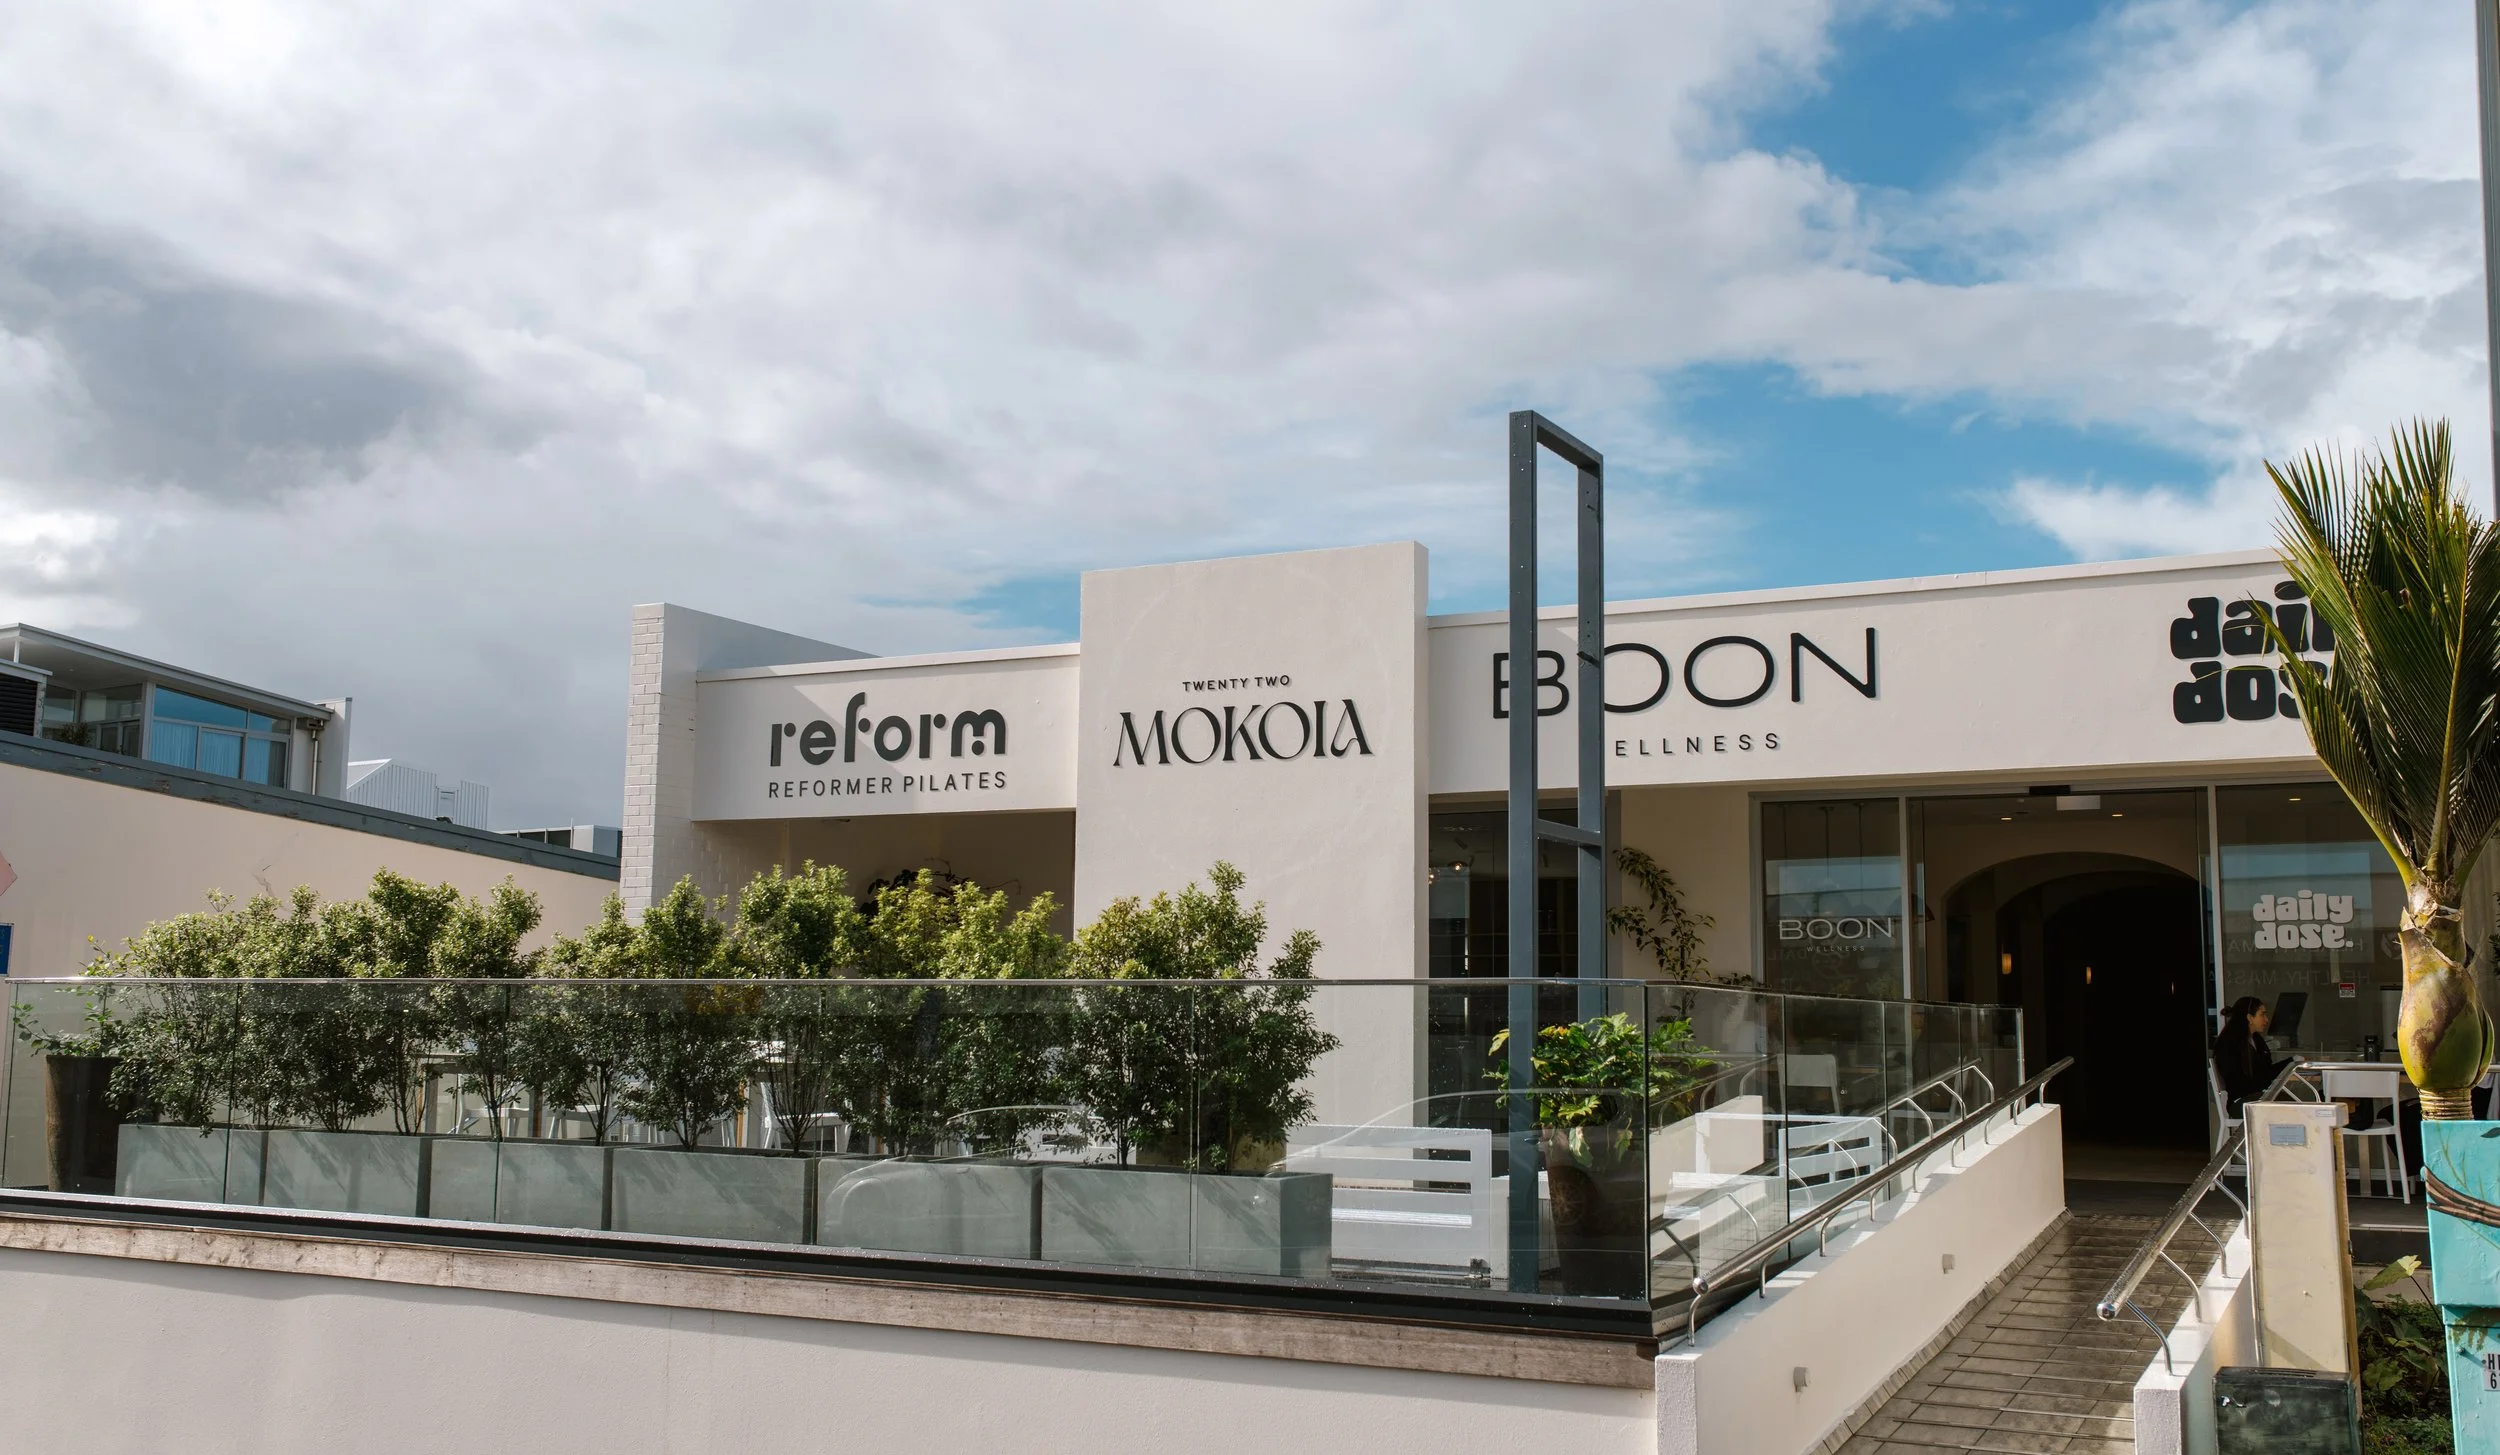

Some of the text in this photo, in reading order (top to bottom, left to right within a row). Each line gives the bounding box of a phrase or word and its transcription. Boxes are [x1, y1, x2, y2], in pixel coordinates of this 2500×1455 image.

[2170, 580, 2336, 660] dail
[1183, 675, 1292, 692] TWENTY TWO
[1493, 627, 1878, 719] BOON
[770, 692, 1007, 769] reform
[1114, 699, 1374, 768] MOKOIA
[1615, 732, 1781, 757] ELLNESS
[769, 771, 1007, 799] REFORMER PILATES
[2253, 889, 2354, 924] daily
[1779, 917, 1893, 940] BOON
[2254, 922, 2354, 949] dose.
